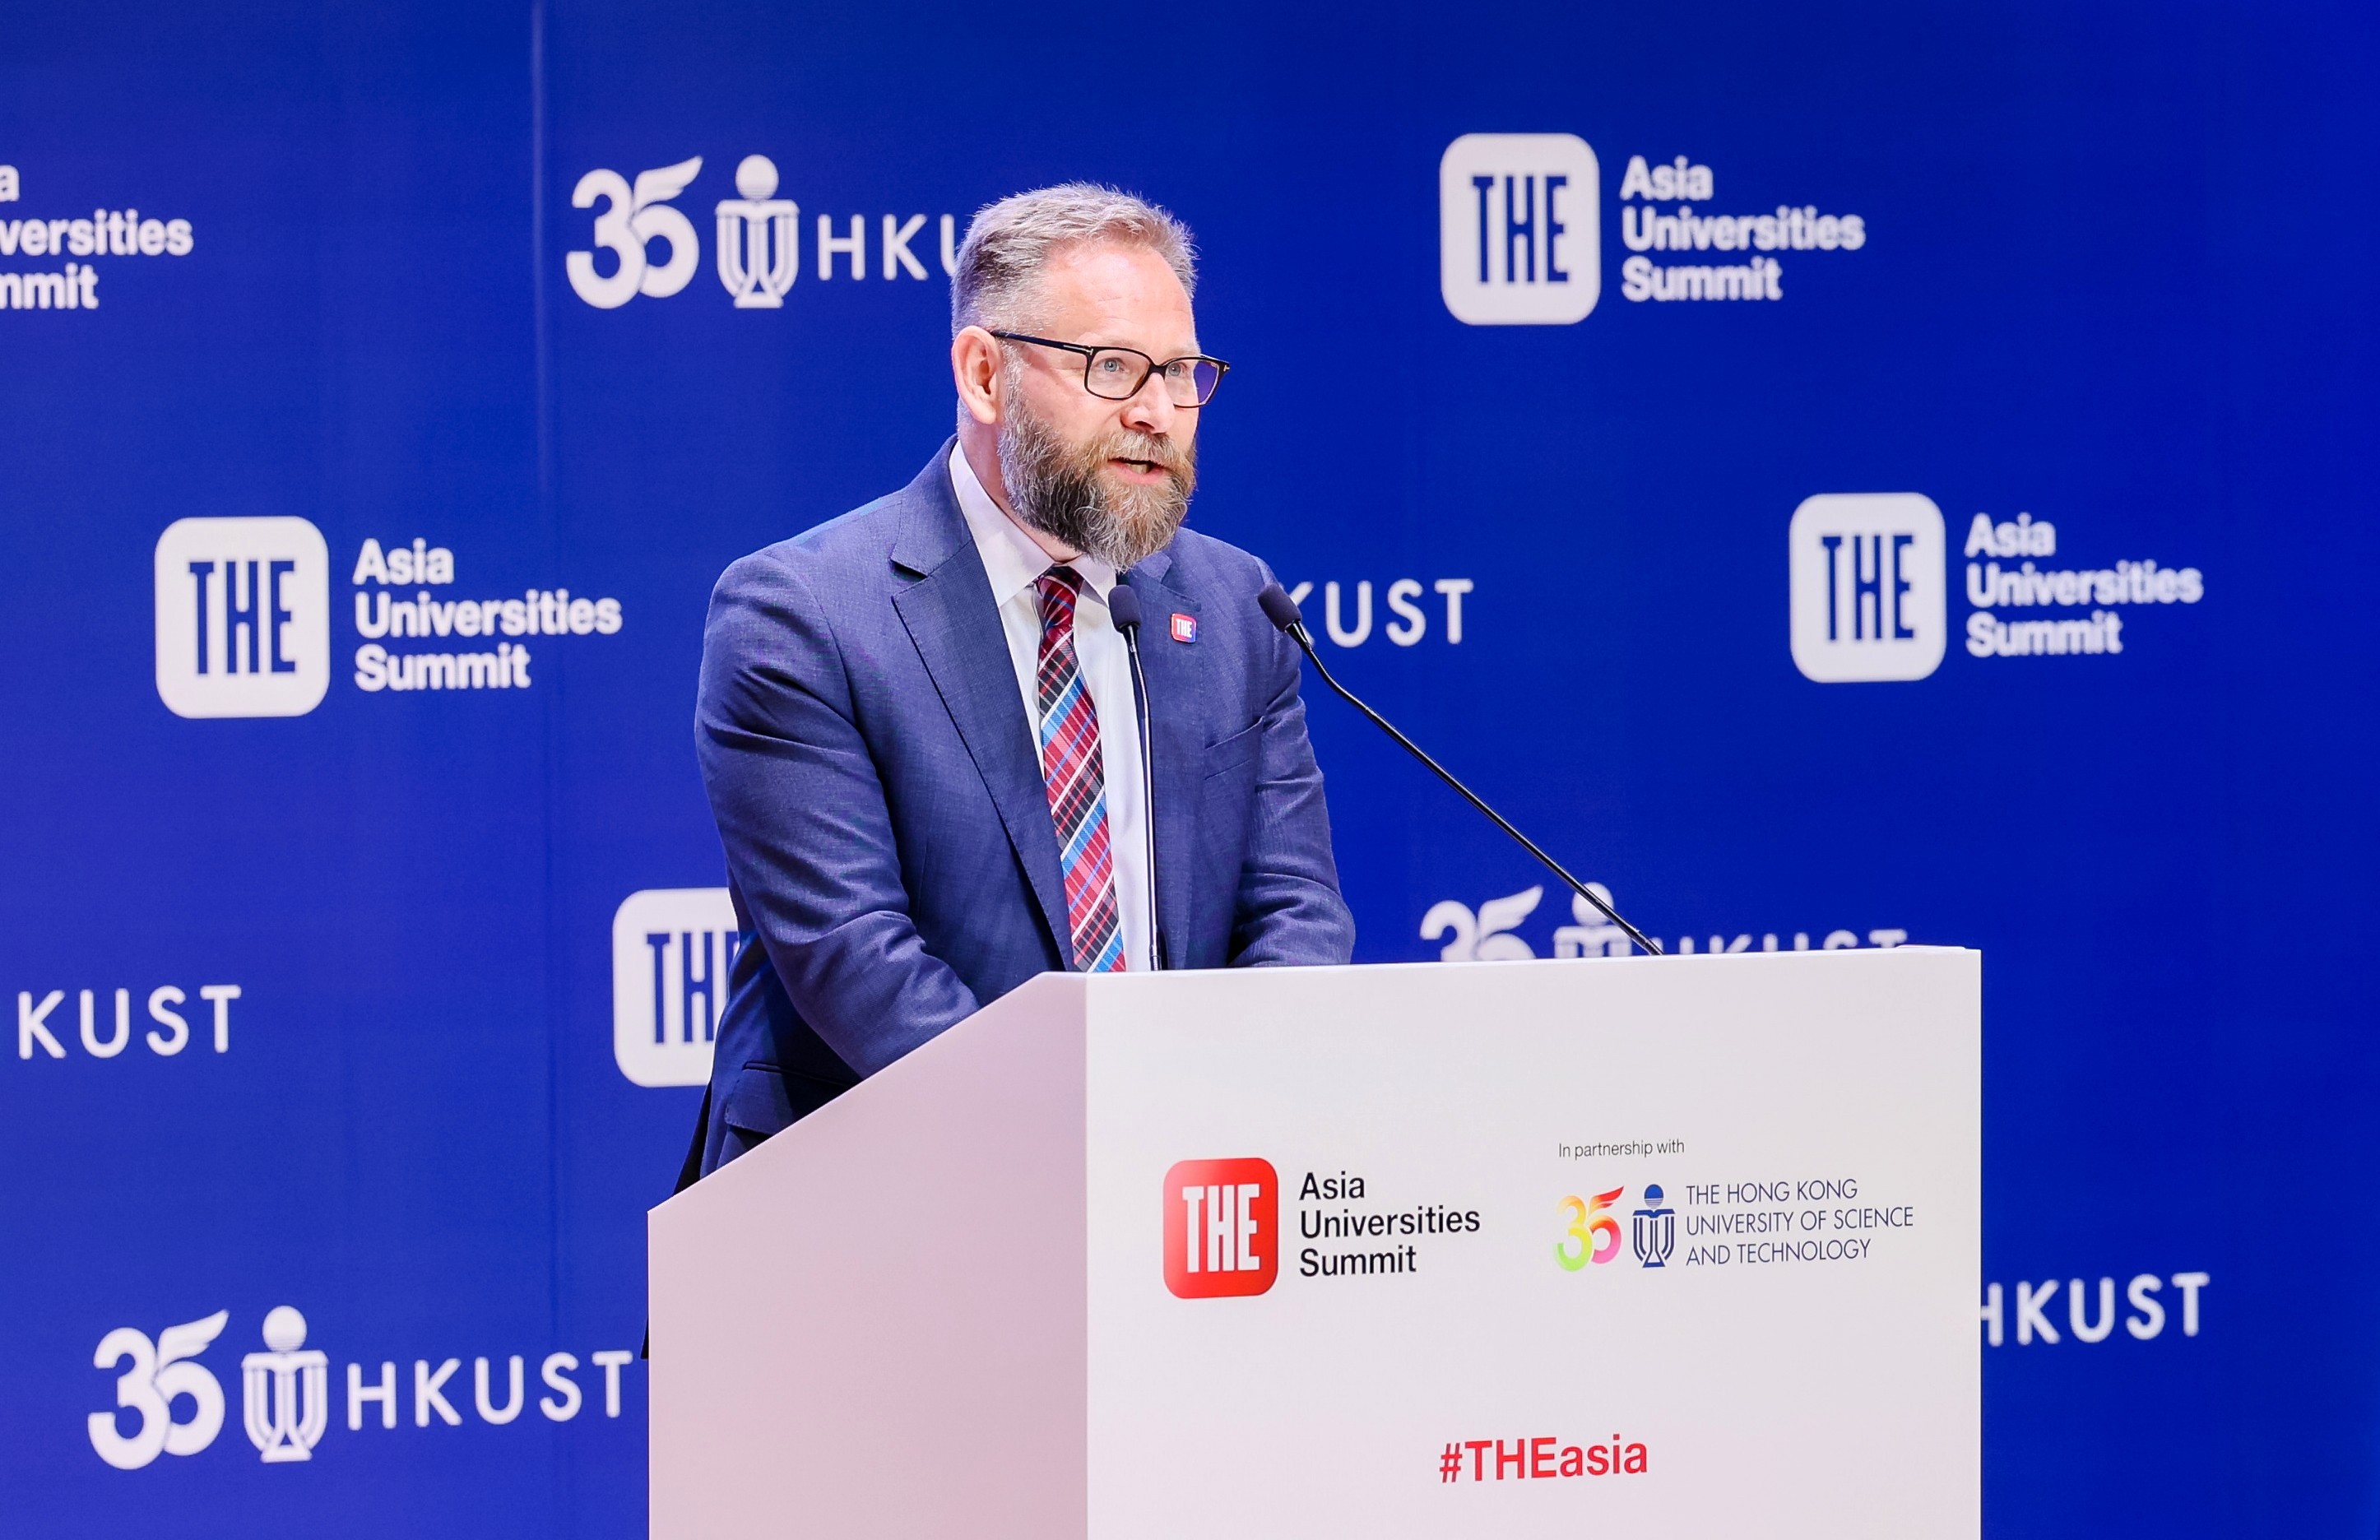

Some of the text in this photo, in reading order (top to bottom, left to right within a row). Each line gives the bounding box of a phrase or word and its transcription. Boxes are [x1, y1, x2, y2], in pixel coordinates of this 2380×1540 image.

[1621, 156, 1712, 200] Asia
[1473, 176, 1568, 283] THE
[1623, 206, 1865, 251] Universities
[1622, 257, 1781, 301] Summit
[1965, 513, 2055, 557] Asia
[353, 538, 453, 585] Asia
[1967, 561, 2202, 607] Universities
[1821, 535, 1914, 641] THE
[189, 561, 295, 674] THE
[355, 589, 622, 638] Universities
[1176, 619, 1192, 638] THE
[1967, 611, 2122, 656] Summit
[355, 642, 531, 691] Summit
[1560, 1139, 1684, 1161] In partnership with
[1299, 1171, 1364, 1200] Asia
[1686, 1179, 1858, 1205] THE HONG KONG
[1183, 1184, 1260, 1273] THE
[1301, 1205, 1480, 1238] Universities
[1687, 1207, 1913, 1236] UNIVERSITY OF SCIENCE
[1300, 1245, 1416, 1277] Summit
[1686, 1238, 1871, 1266] AND TECHNOLOGY
[347, 1351, 633, 1431] HKUST
[1440, 1433, 1648, 1483] #THEasia
